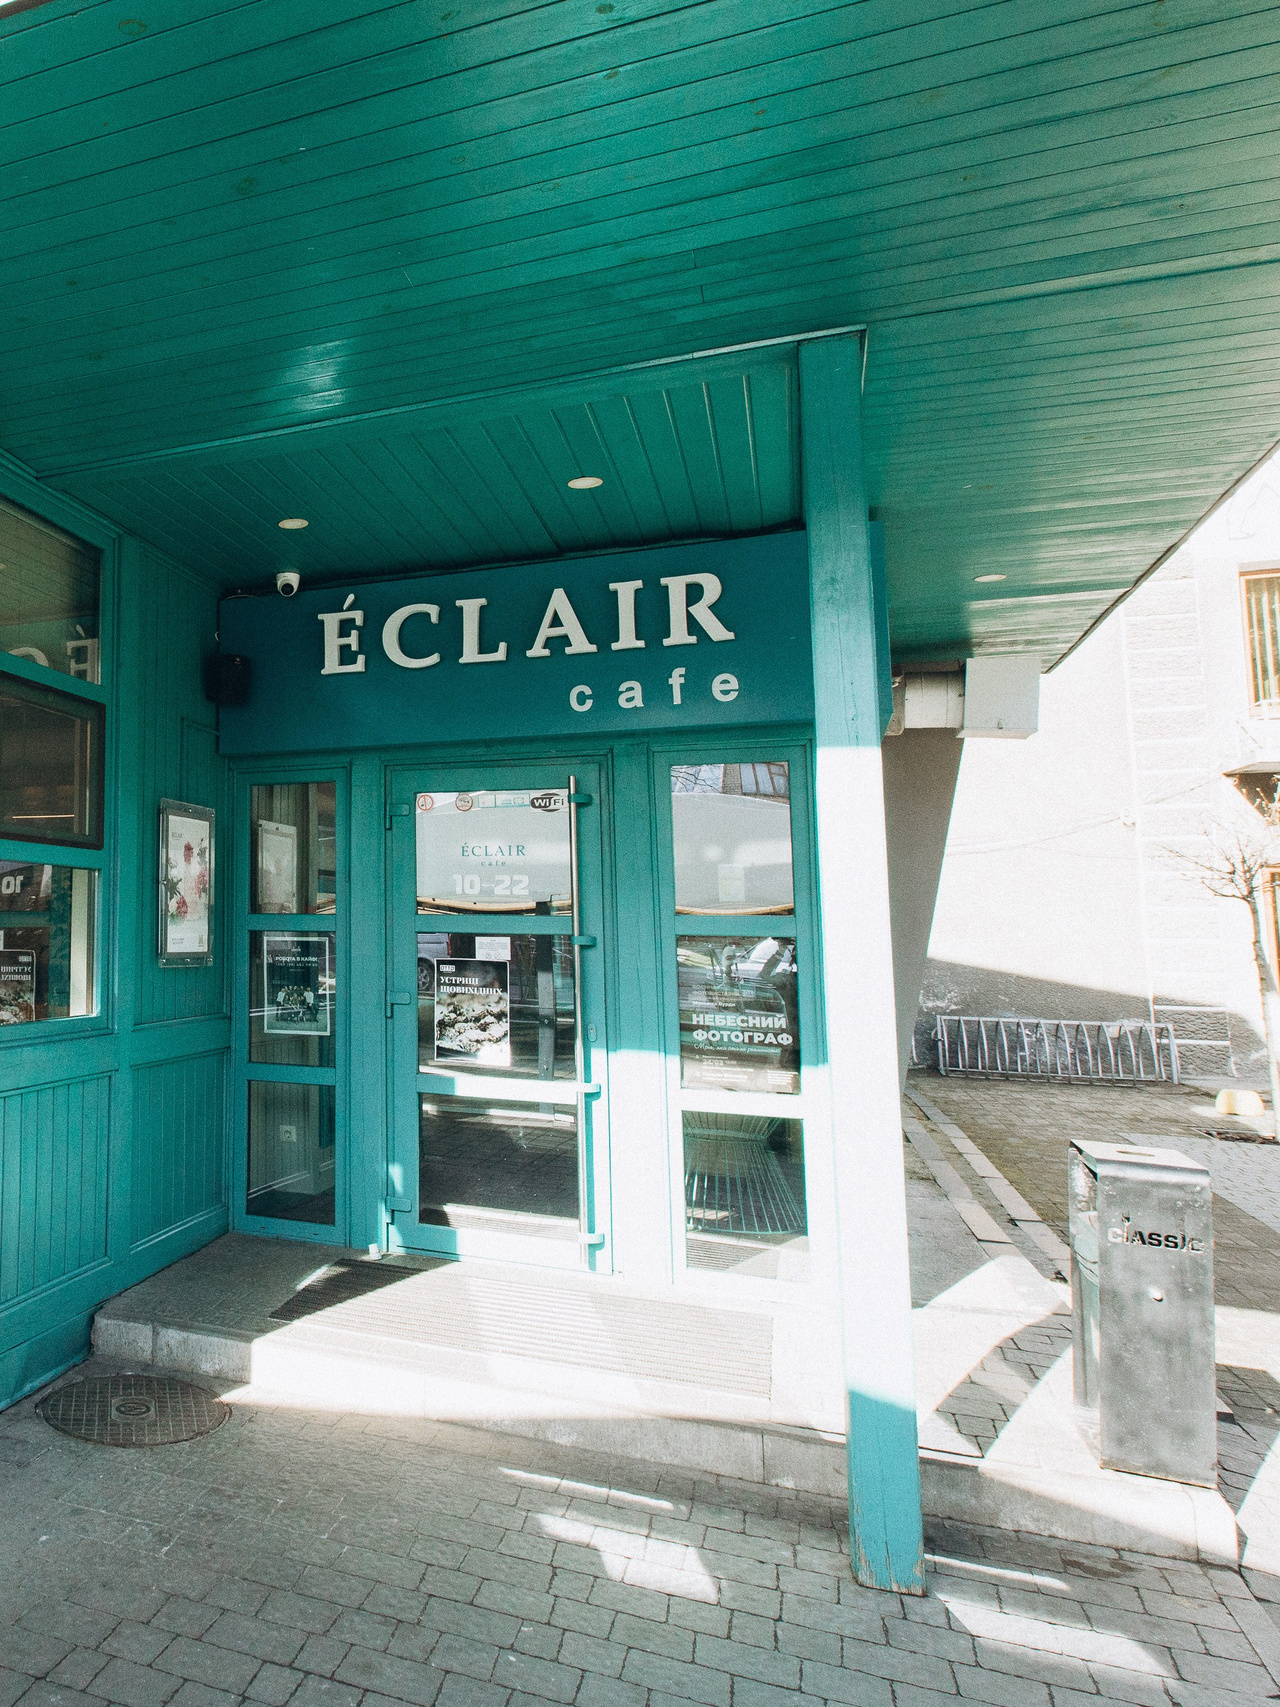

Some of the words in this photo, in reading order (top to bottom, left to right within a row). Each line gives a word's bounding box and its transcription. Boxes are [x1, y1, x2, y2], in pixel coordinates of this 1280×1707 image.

[318, 572, 736, 676] ÉCLAIR
[569, 666, 740, 712] cafe
[461, 842, 526, 857] ÉCLAIR
[480, 859, 507, 867] cafe
[440, 976, 479, 985] УСТРИЦІ
[692, 1013, 787, 1029] НЕБЕСНИЙ
[692, 1028, 793, 1046] ФОТОГРАФ
